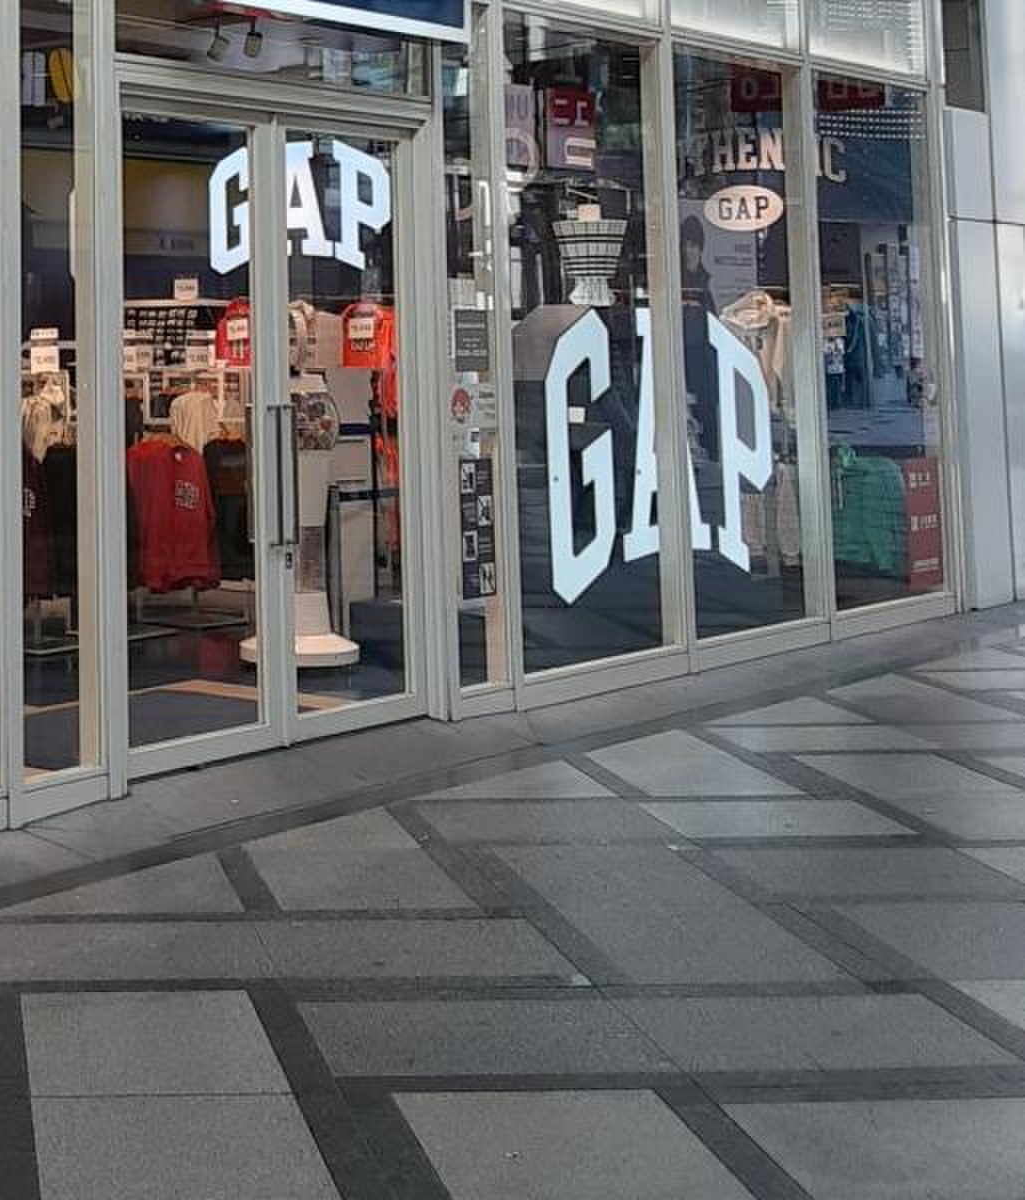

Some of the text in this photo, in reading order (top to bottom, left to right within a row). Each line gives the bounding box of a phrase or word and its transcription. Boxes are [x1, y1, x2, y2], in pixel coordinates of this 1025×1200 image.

[208, 139, 392, 275] GAP
[717, 195, 769, 221] GAP
[544, 307, 773, 605] GAP
